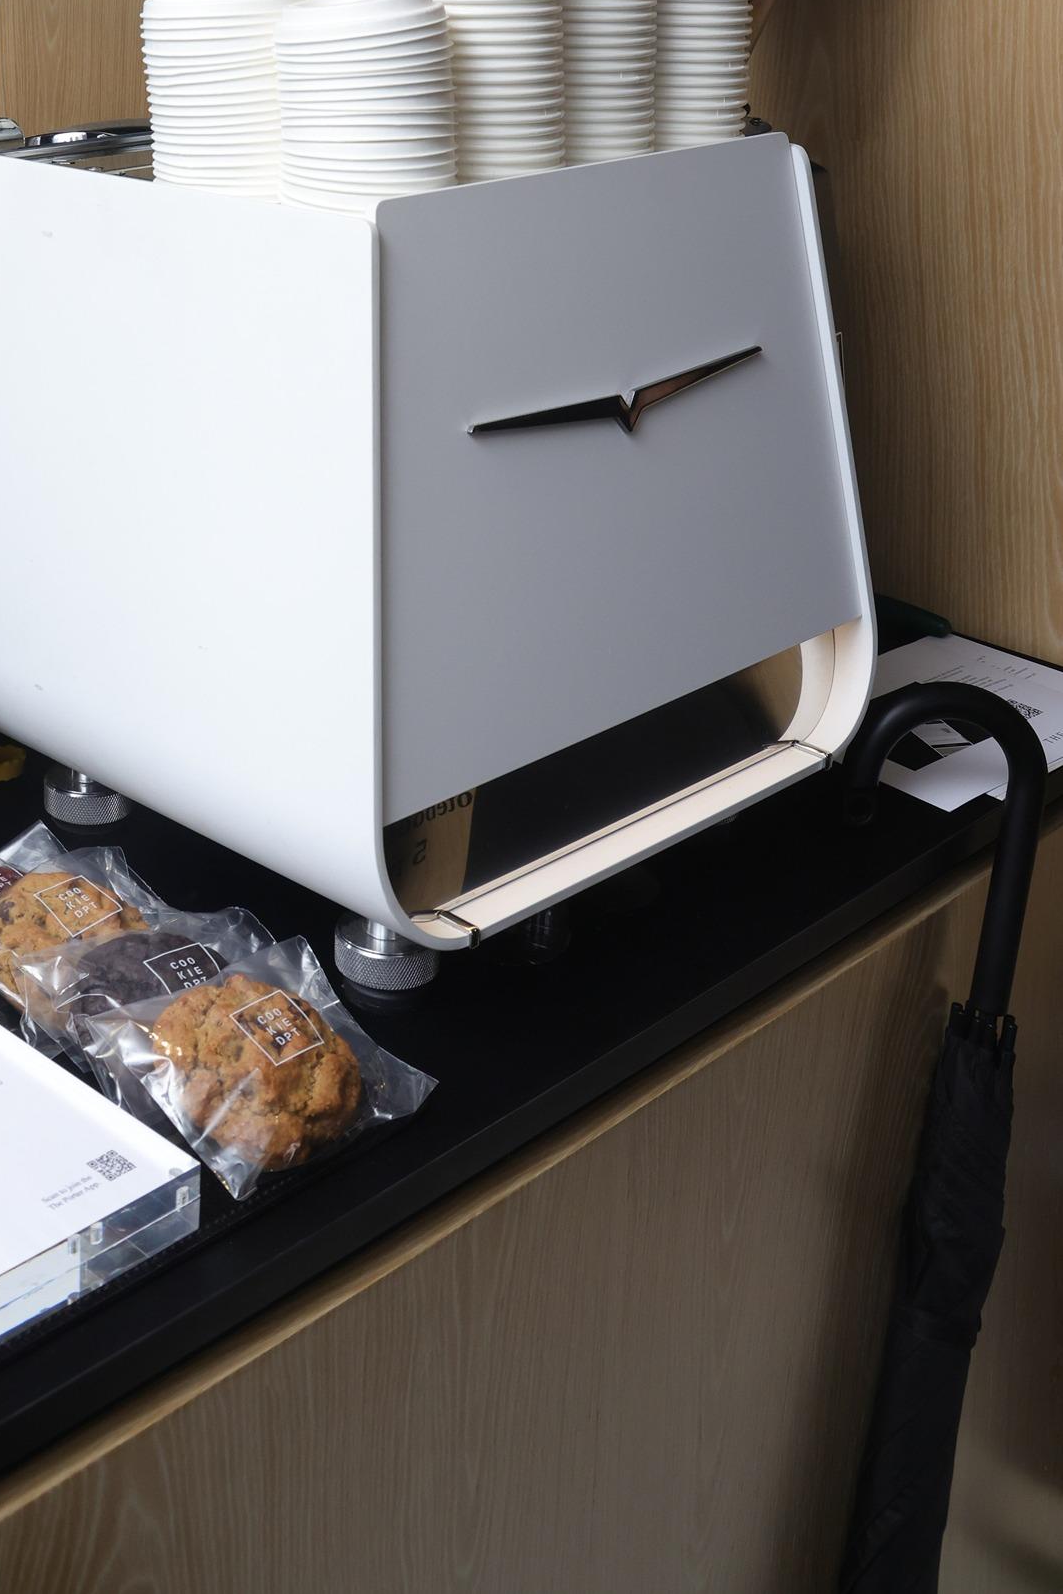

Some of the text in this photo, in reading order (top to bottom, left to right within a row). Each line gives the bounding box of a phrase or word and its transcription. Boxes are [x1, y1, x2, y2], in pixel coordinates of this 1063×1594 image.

[58, 887, 82, 901] COO
[66, 894, 90, 910] KIE
[74, 901, 98, 919] DPT
[169, 957, 196, 970] COO
[177, 966, 204, 980] KIE
[257, 1008, 282, 1025] COO
[266, 1018, 293, 1036] KIE
[275, 1027, 301, 1046] DPT
